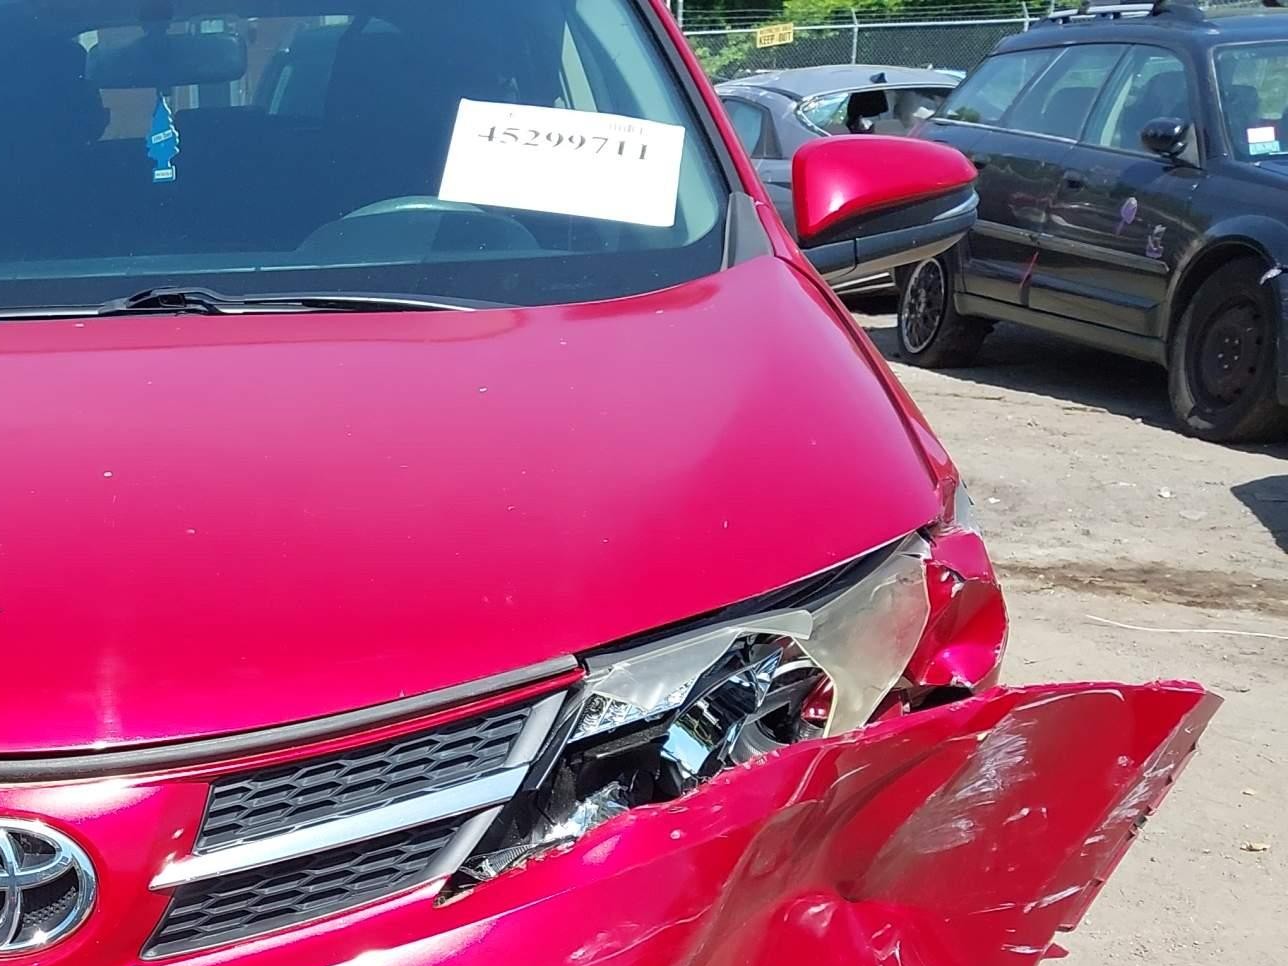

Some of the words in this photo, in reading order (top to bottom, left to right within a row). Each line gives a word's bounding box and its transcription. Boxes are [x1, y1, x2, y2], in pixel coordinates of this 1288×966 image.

[759, 34, 775, 45] KEEP
[778, 32, 792, 41] OUT
[478, 126, 648, 160] 45299711
